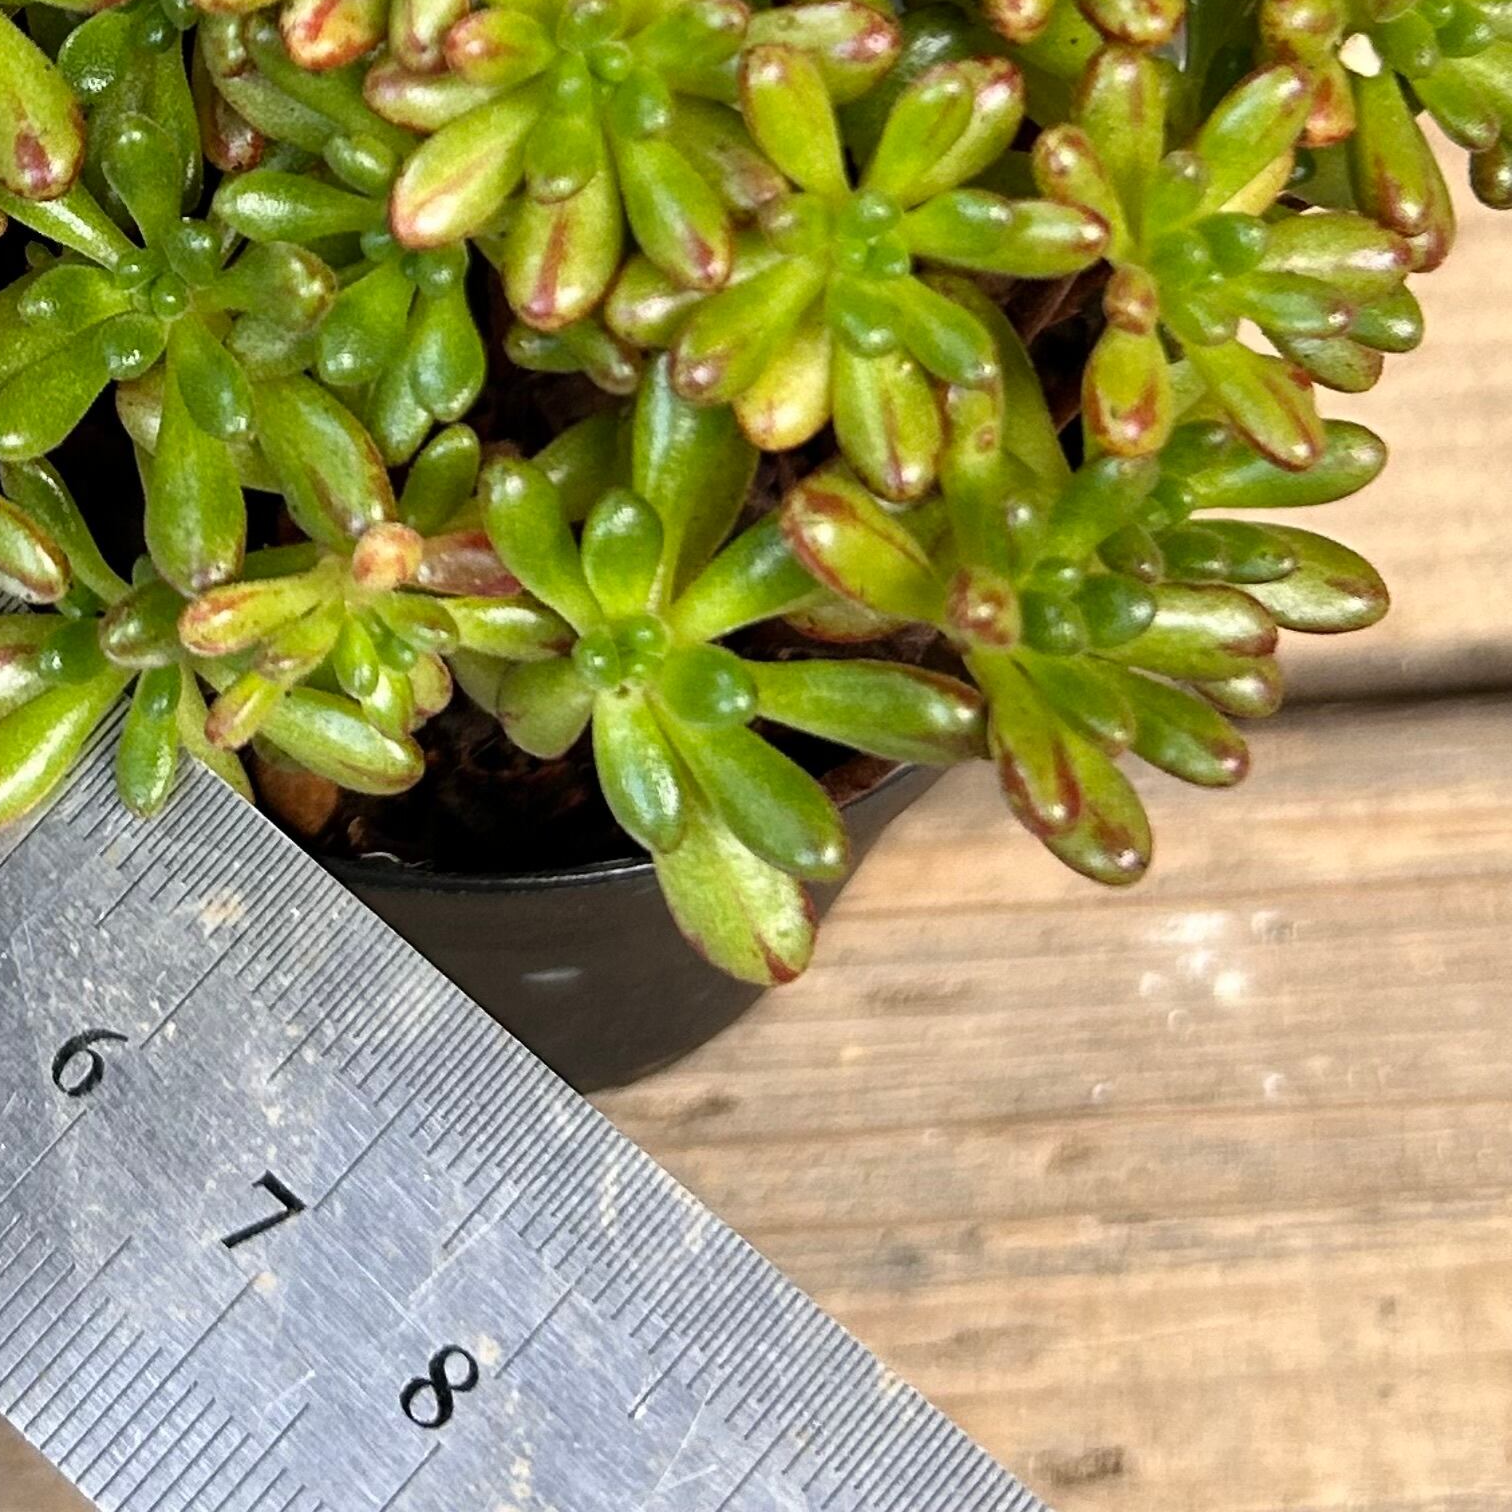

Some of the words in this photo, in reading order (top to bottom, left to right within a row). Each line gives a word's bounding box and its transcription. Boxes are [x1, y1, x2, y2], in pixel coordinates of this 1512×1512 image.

[51, 1028, 130, 1098] 6
[221, 1169, 307, 1250] 7
[400, 1344, 480, 1429] 8
